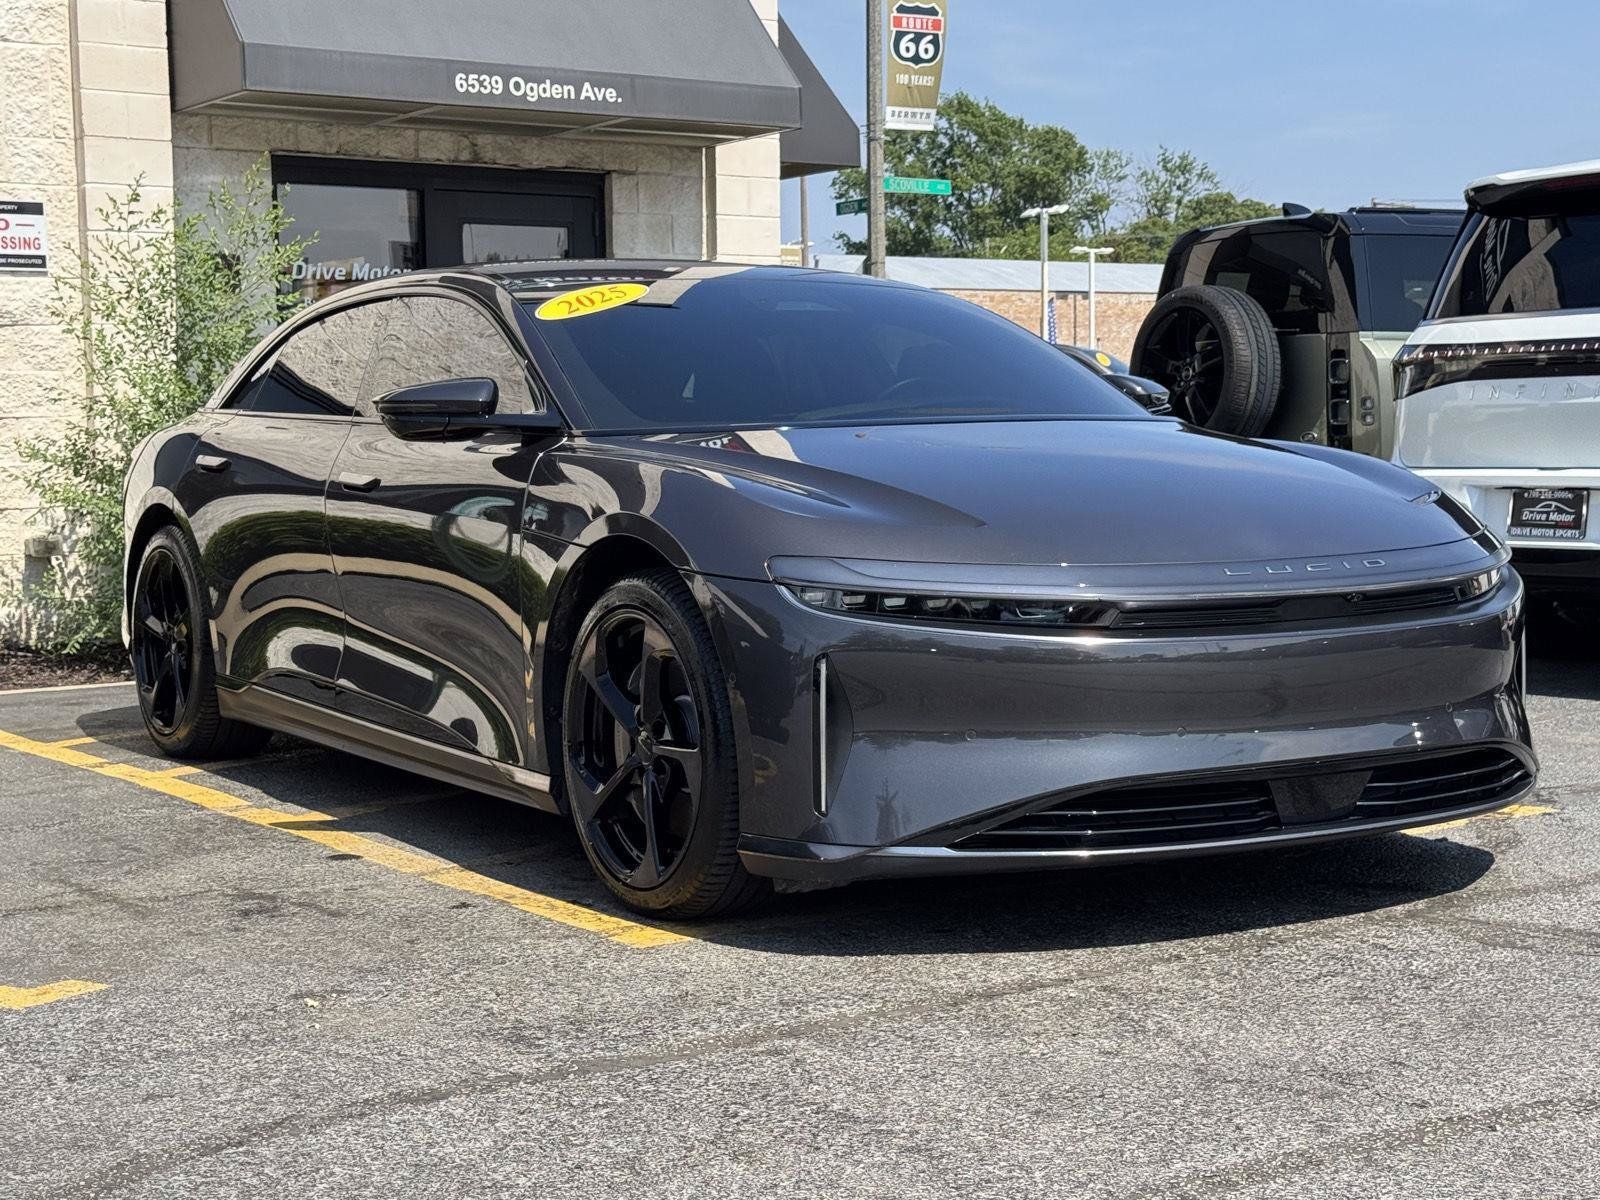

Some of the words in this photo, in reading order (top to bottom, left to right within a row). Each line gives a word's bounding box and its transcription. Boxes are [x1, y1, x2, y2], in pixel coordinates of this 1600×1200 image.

[901, 16, 934, 30] ROUTE
[899, 33, 935, 60] 66
[895, 73, 909, 85] 100
[454, 73, 504, 95] 6539
[508, 76, 576, 102] Ogden
[580, 82, 623, 103] Ave.
[890, 110, 932, 121] BERWYN
[291, 261, 347, 280] Drive
[556, 286, 628, 315] 2025
[1521, 511, 1547, 521] Drive
[1548, 512, 1576, 522] Motor
[1531, 527, 1554, 537] MOTOR
[1554, 529, 1580, 538] SPORTS
[1223, 558, 1386, 576] LUCID
